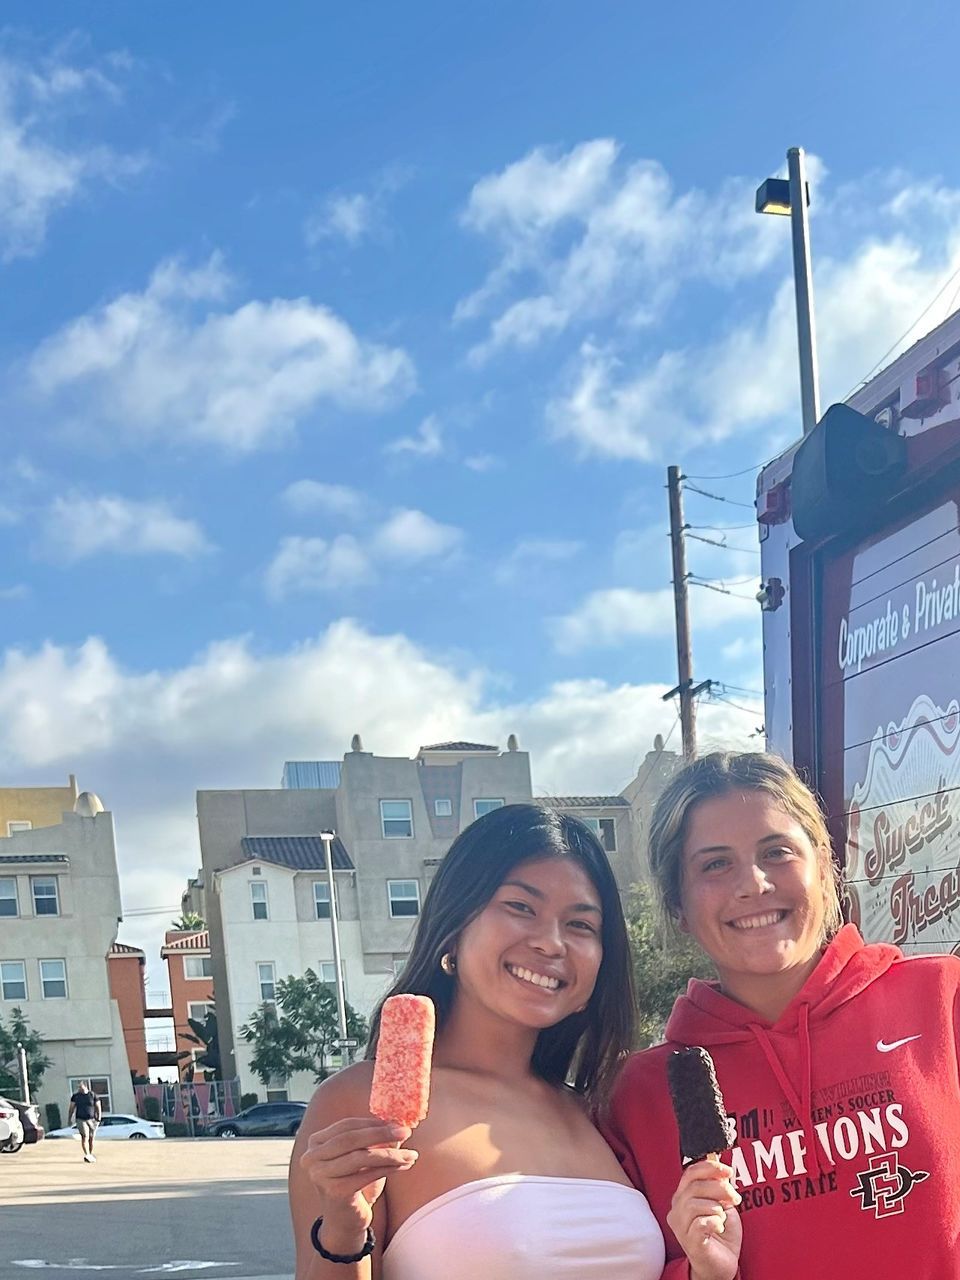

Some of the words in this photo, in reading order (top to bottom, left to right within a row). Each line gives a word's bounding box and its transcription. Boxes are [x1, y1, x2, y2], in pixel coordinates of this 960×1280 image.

[838, 600, 898, 672] Corporate
[902, 604, 910, 639] &
[864, 775, 951, 884] Sweet
[850, 1089, 897, 1111] SOCCER
[781, 1171, 838, 1203] STATE
